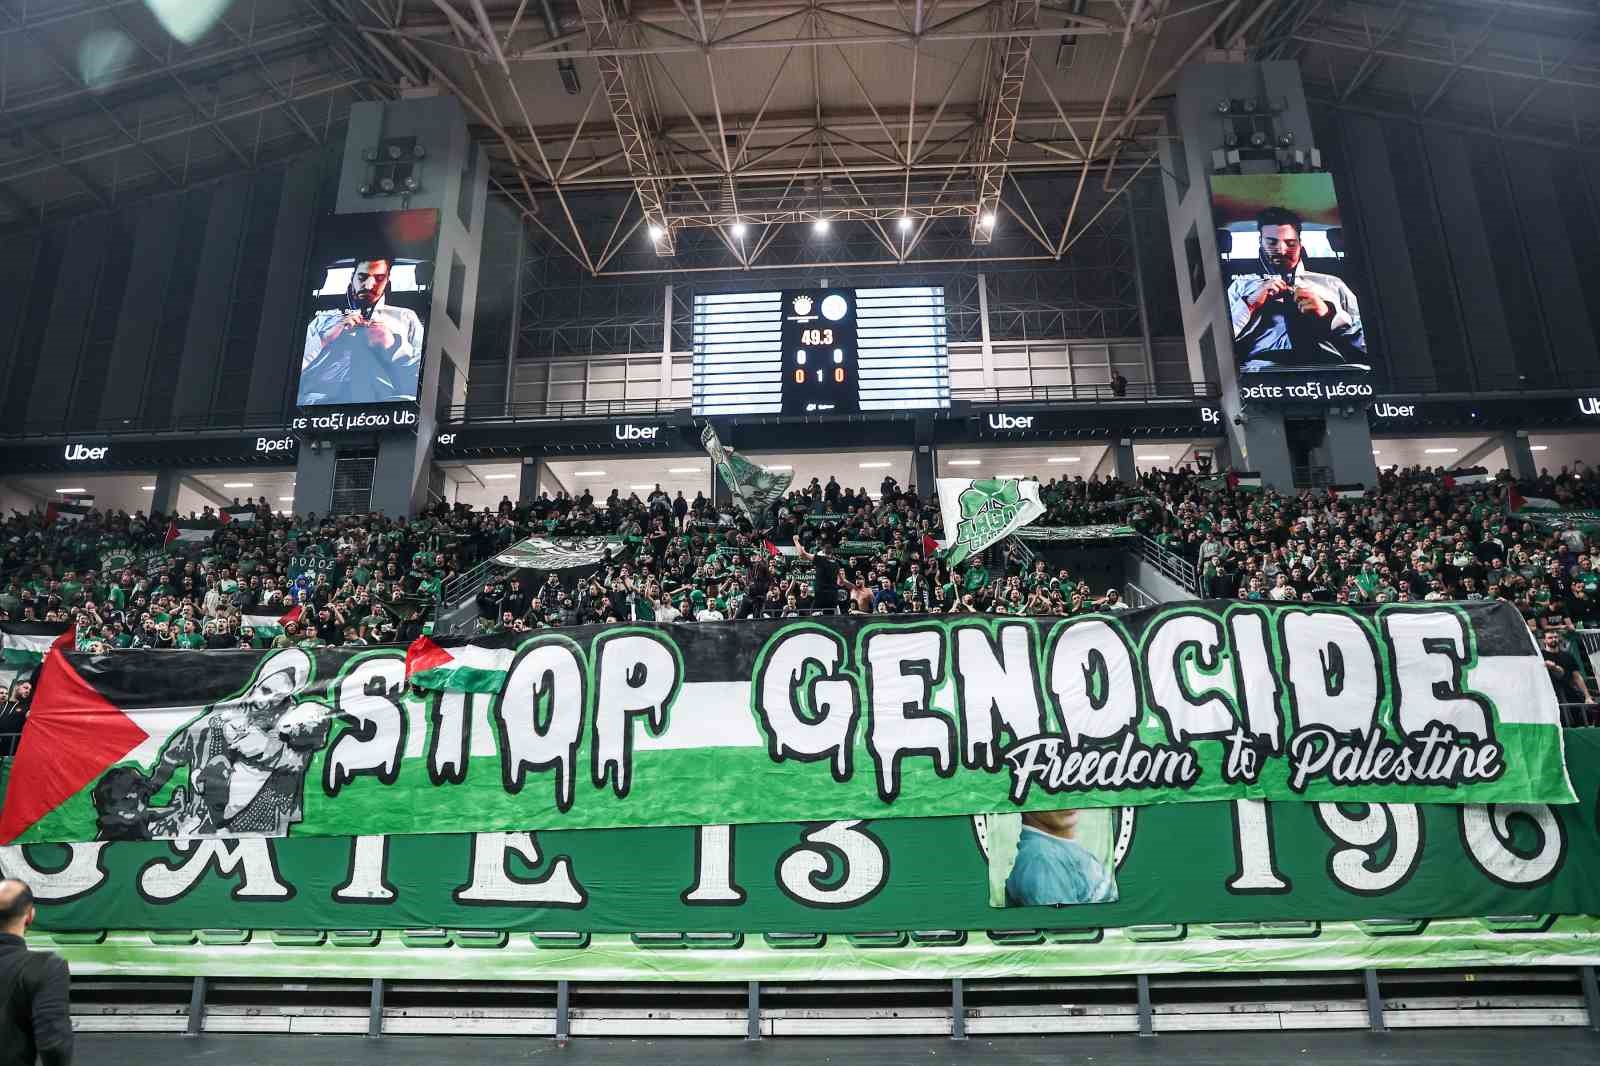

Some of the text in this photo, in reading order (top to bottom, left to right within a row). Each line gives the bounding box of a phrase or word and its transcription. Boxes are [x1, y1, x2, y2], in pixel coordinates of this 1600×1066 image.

[795, 367, 845, 384] 0 1 0
[1285, 382, 1323, 400] ταξί
[1325, 382, 1373, 400] μέσω
[1374, 402, 1415, 417] Uber
[310, 413, 344, 430] ταξί
[346, 412, 390, 430] μέσω
[393, 411, 416, 425] Ub
[988, 413, 1035, 429] Uber
[615, 424, 660, 440] Uber
[64, 444, 109, 461] Uber
[322, 604, 1493, 813] STOP GENOCIDE
[1002, 725, 1505, 802] Freedom to Palestine
